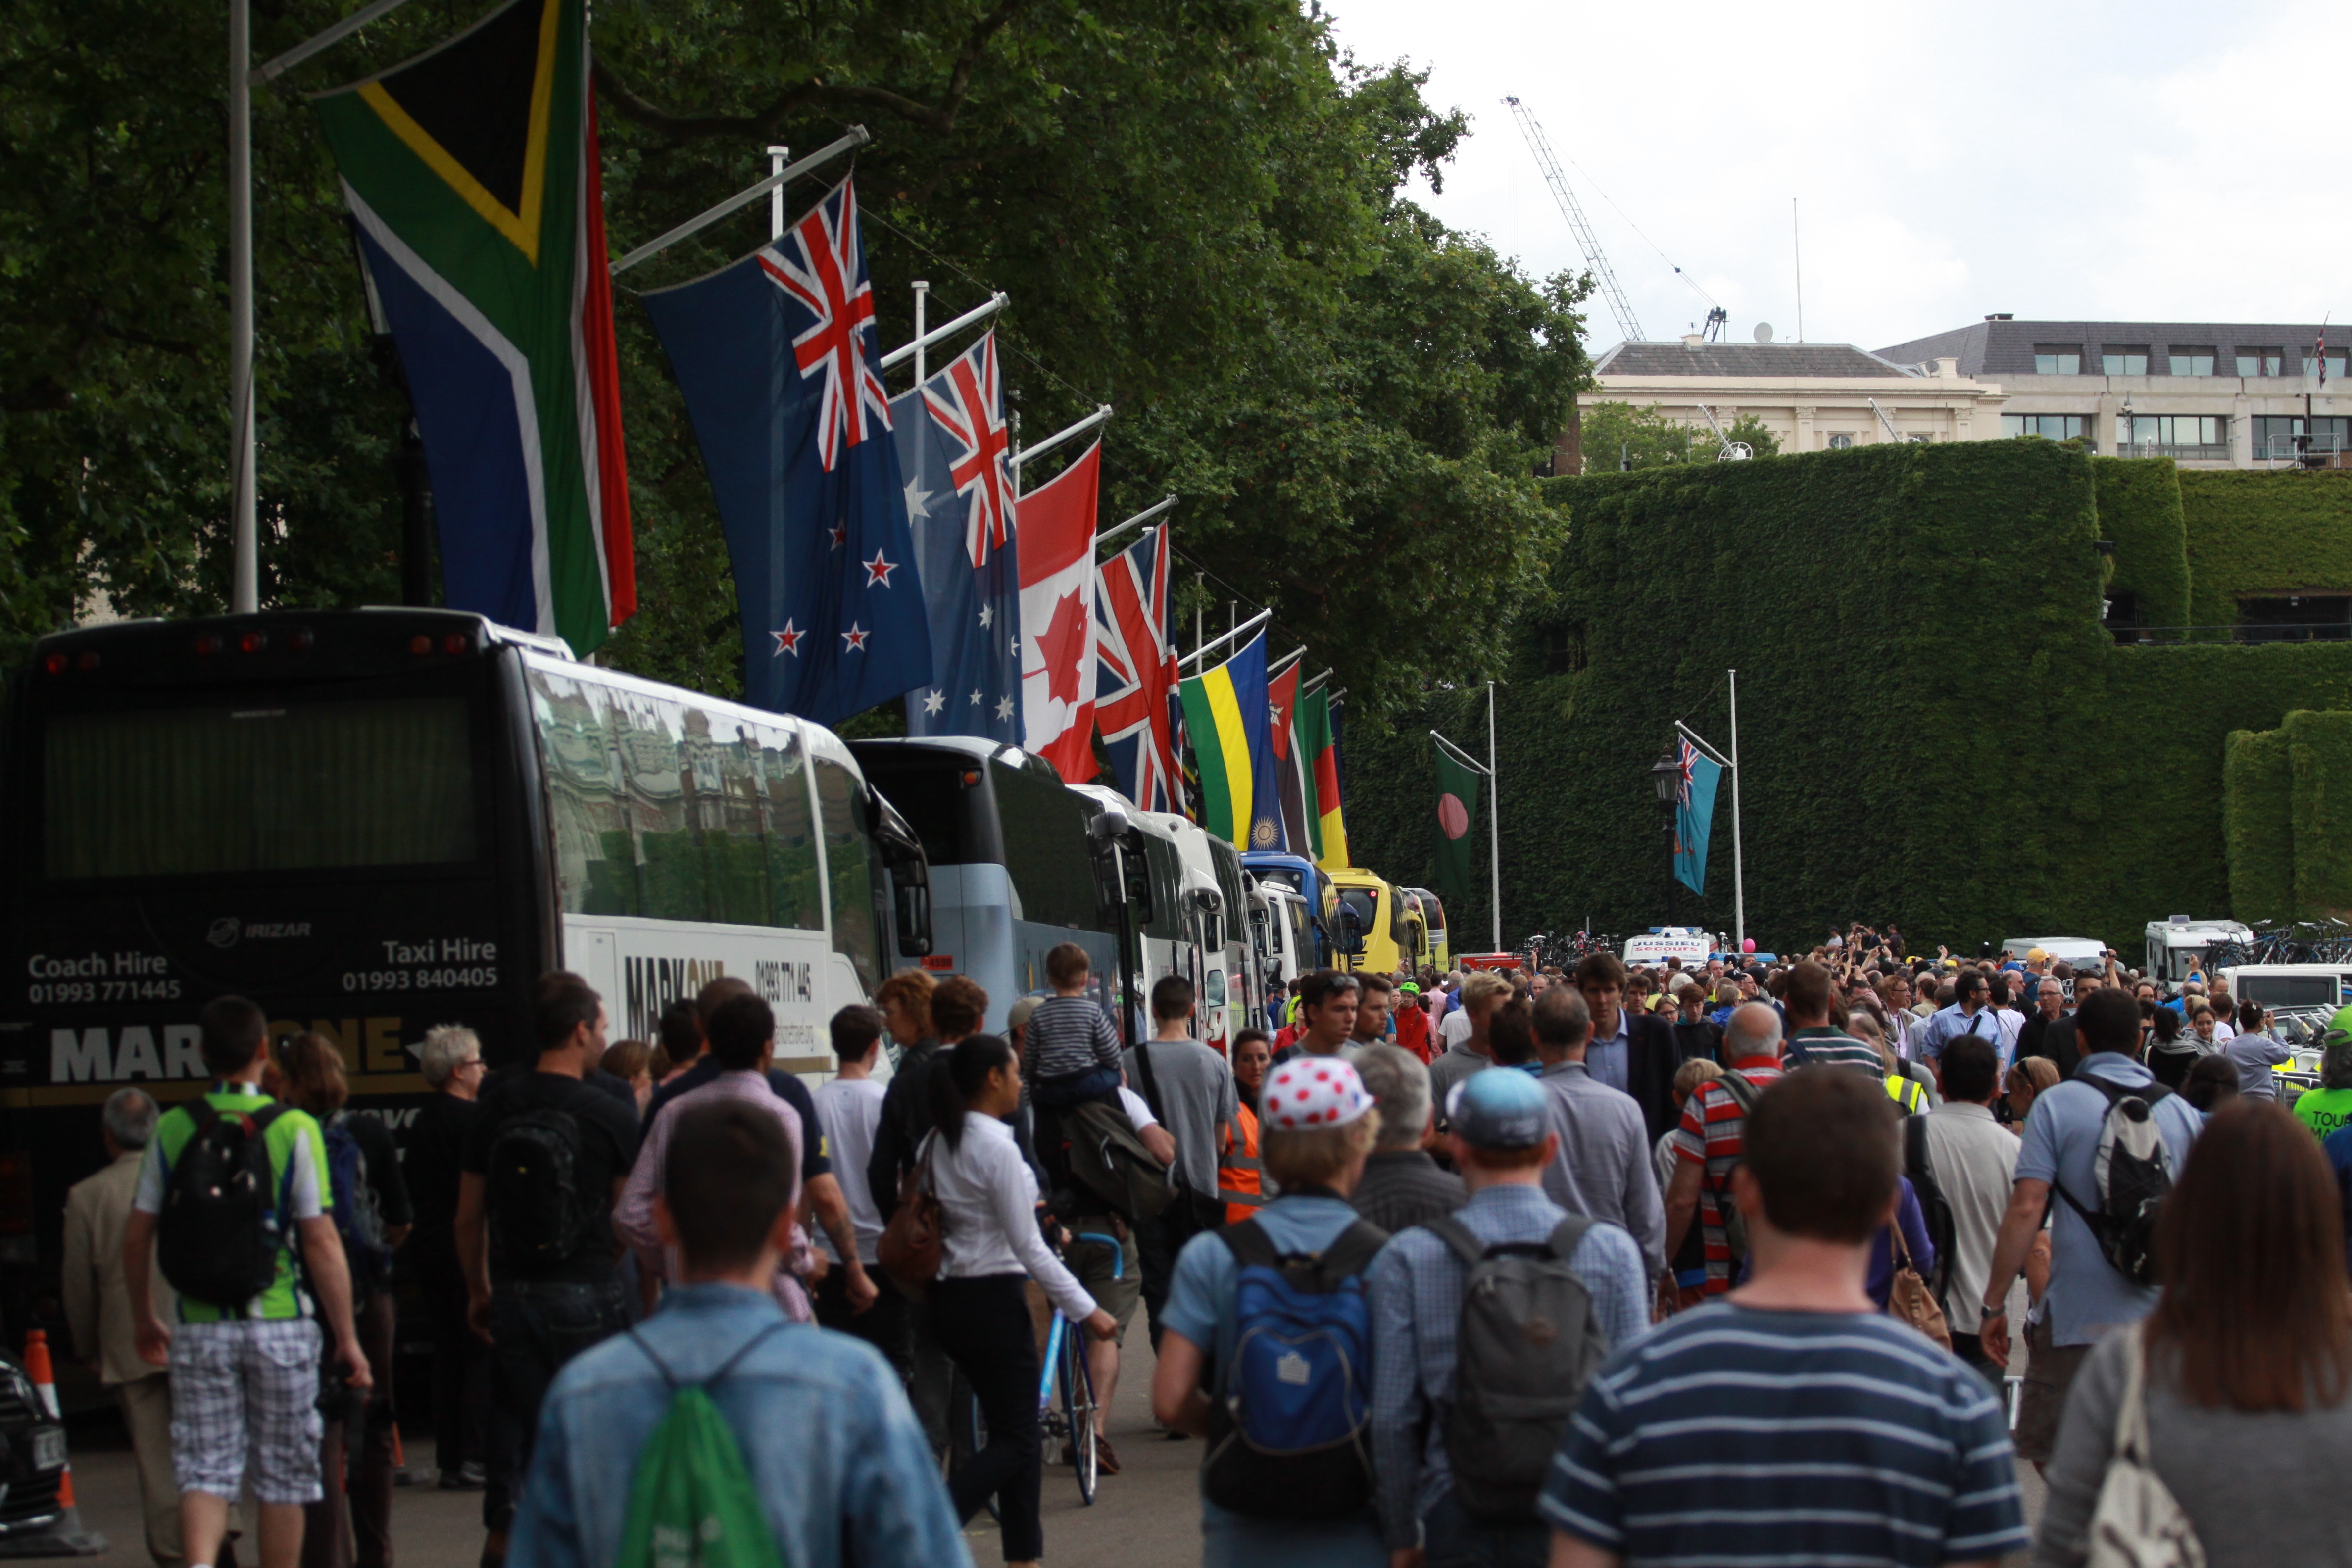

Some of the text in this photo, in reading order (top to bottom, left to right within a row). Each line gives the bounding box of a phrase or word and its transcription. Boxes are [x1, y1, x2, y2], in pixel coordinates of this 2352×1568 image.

[245, 922, 312, 938] IRIZAR
[382, 938, 497, 964] Taxi Hire
[28, 951, 168, 979] Coach Hire
[29, 980, 181, 1004] 01993 771445
[343, 967, 497, 991] 01993 840405
[756, 960, 780, 1002] 01993
[782, 962, 796, 1002] 771
[798, 962, 811, 1002] 445
[51, 1024, 210, 1083] MAR
